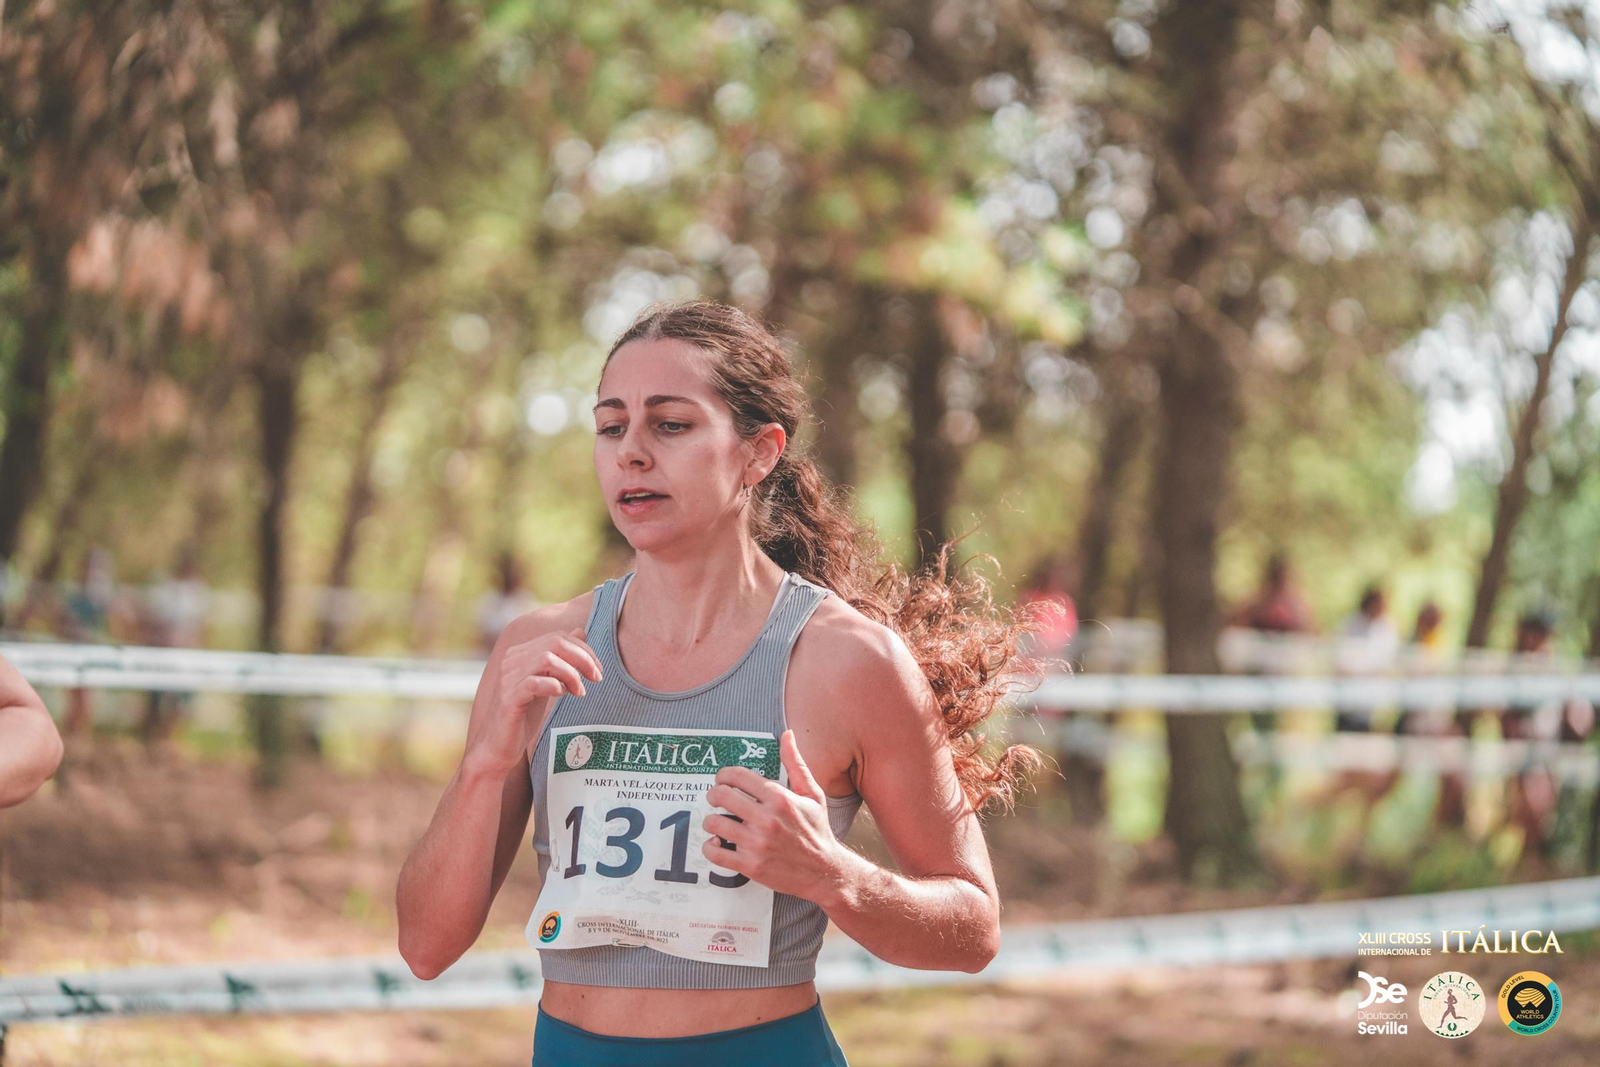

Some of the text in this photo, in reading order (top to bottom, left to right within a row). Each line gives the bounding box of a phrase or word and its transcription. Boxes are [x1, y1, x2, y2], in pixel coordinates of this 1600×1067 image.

[607, 737, 719, 766] ITÁLICA
[606, 763, 661, 771] INTERNATIONAL
[584, 778, 619, 787] MARTA
[622, 779, 683, 792] VELÁZQUEZ
[616, 790, 698, 803] INDEPENDIENTE
[598, 922, 645, 935] INTERNACIONAL
